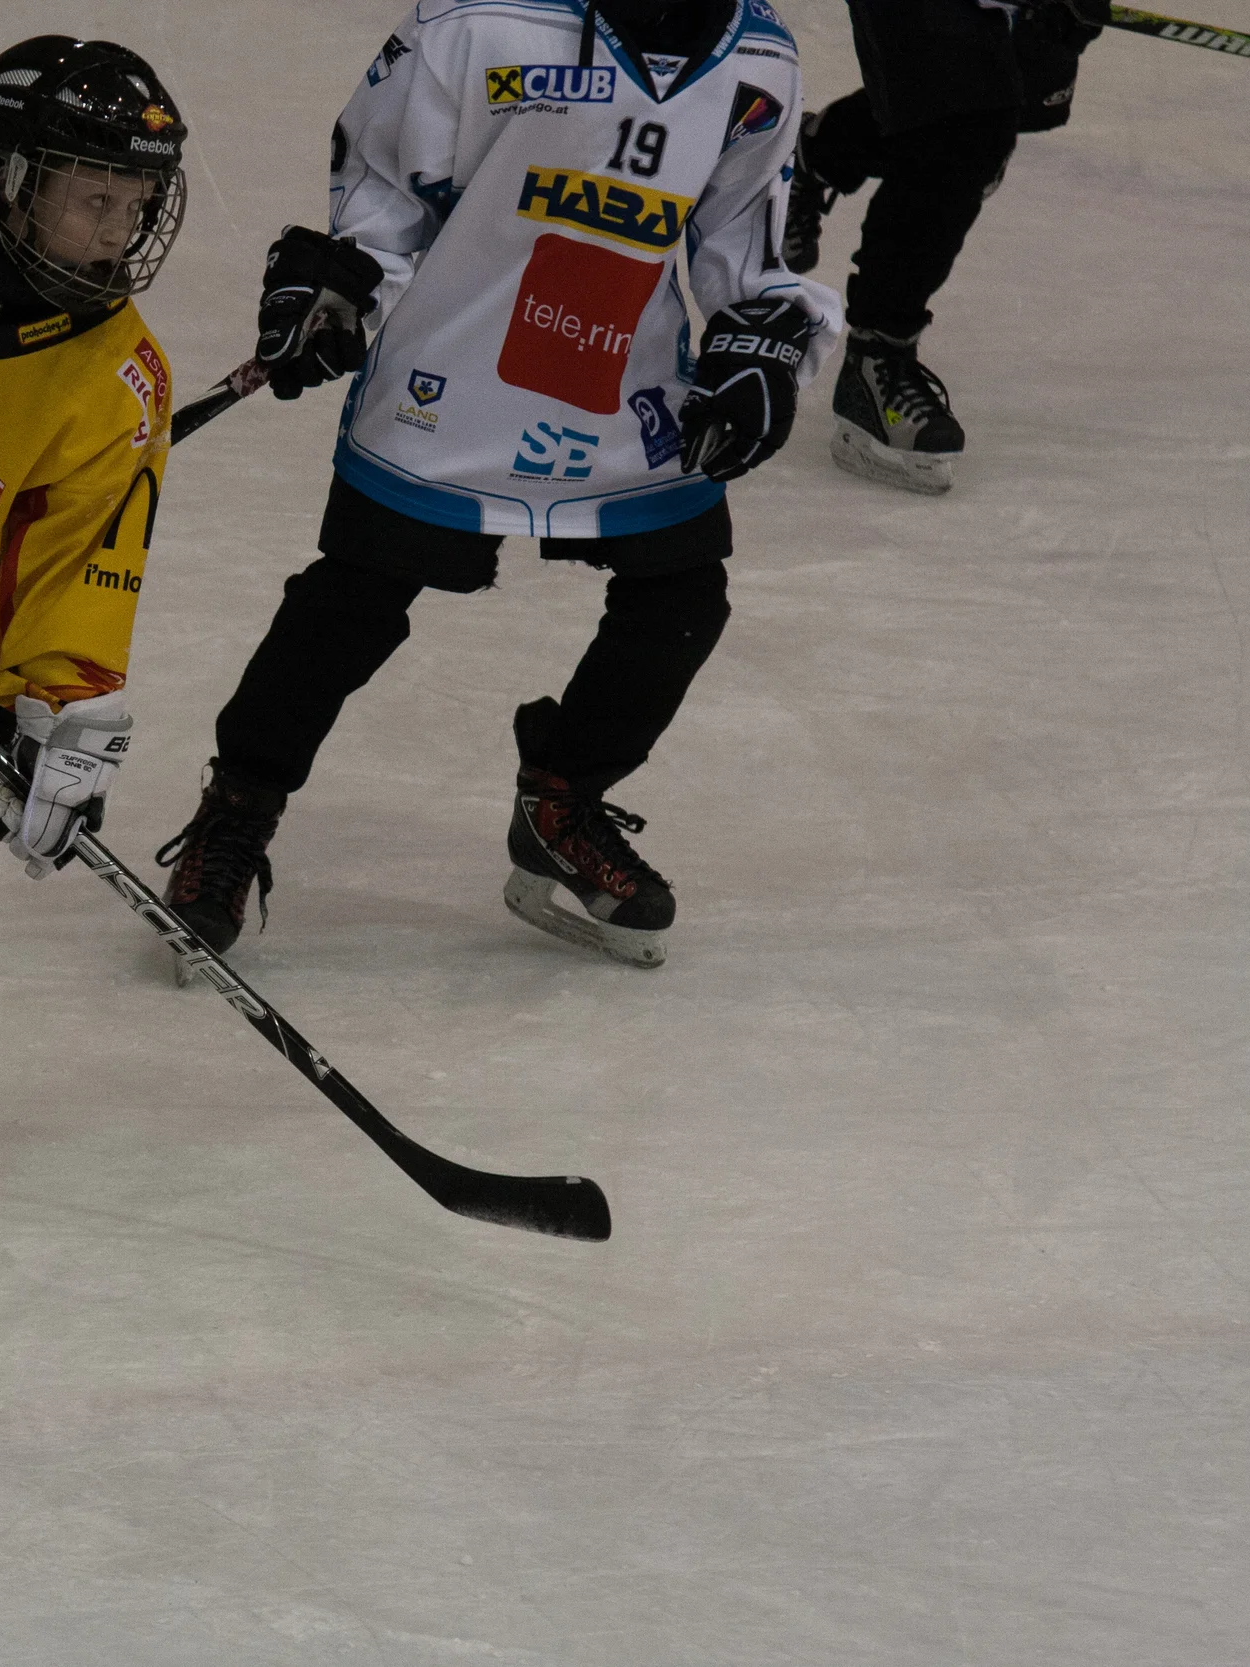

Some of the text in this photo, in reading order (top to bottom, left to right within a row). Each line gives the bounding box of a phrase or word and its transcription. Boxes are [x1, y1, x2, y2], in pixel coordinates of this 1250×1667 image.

[524, 67, 613, 100] CLUB
[130, 136, 176, 156] Reebok
[608, 118, 667, 177] 19
[705, 333, 803, 368] BAUER
[65, 760, 82, 770] ONE
